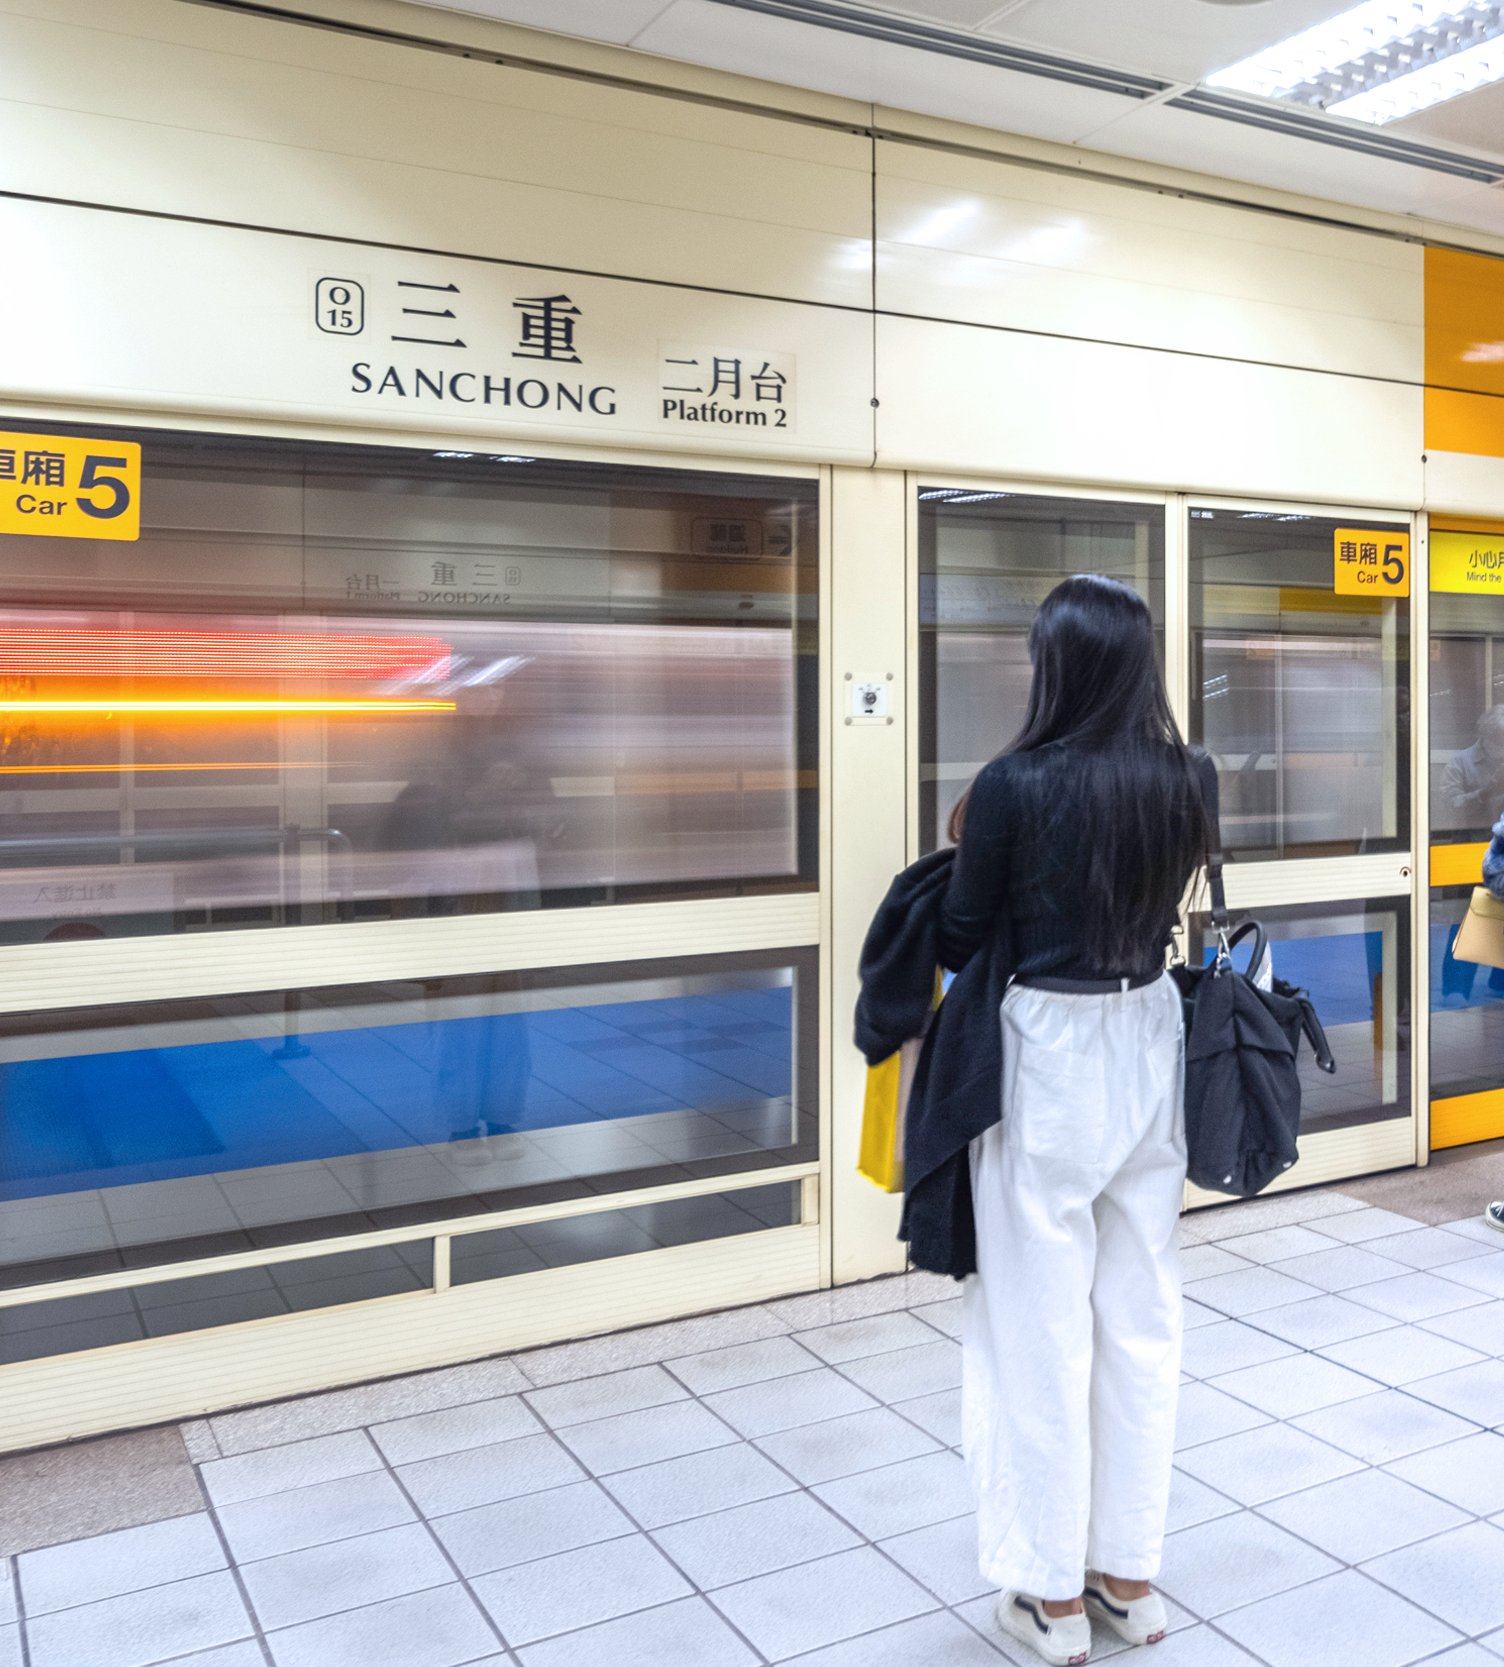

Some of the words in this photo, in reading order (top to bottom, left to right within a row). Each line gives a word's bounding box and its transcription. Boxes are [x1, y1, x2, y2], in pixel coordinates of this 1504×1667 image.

[329, 286, 351, 305] O
[327, 310, 353, 328] 15
[391, 281, 583, 364] 三重
[351, 362, 616, 416] SANCHONG
[662, 356, 787, 403] 二月台
[663, 399, 768, 426] Platform
[774, 408, 788, 428] 2
[76, 454, 131, 519] 5
[16, 494, 68, 516] Car
[1339, 541, 1378, 566] 車廂
[1382, 544, 1405, 585] 5
[1357, 571, 1378, 585] Car
[1466, 572, 1487, 582] Mind
[1489, 573, 1502, 582] the
